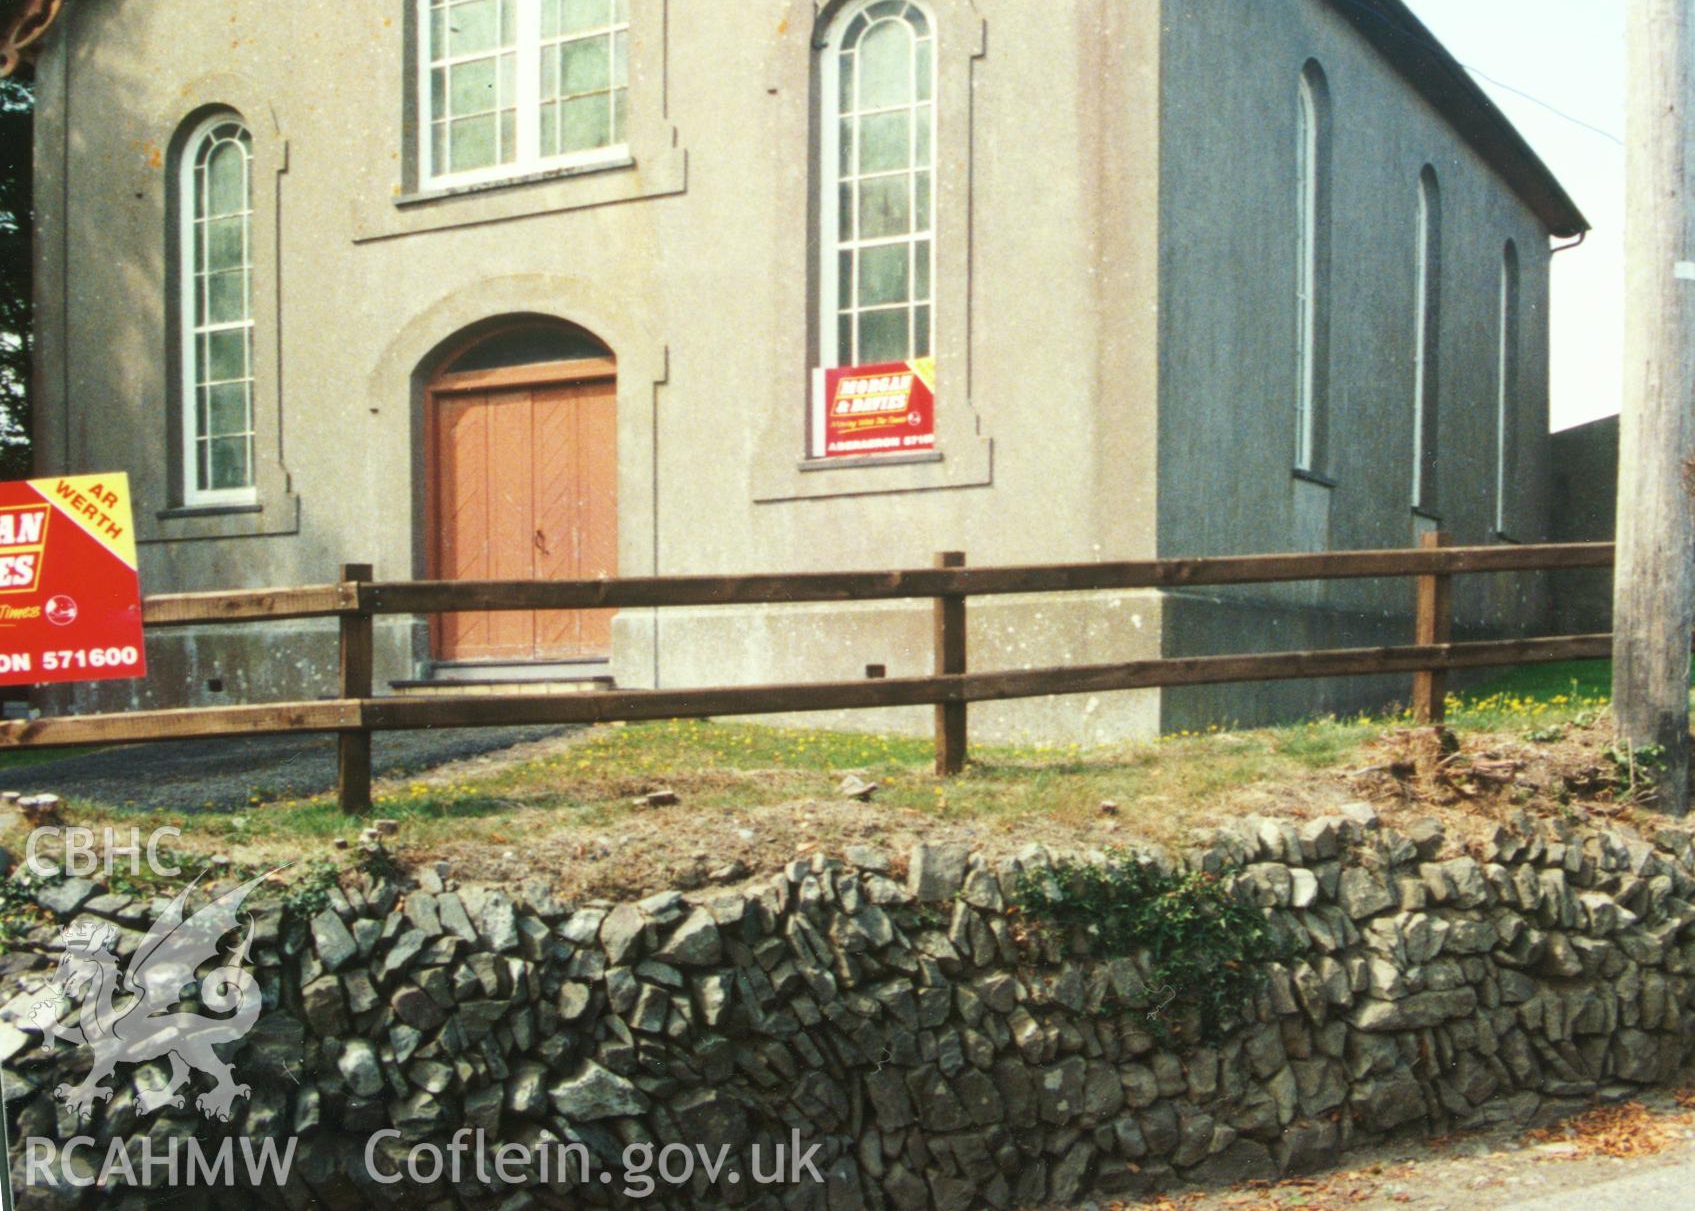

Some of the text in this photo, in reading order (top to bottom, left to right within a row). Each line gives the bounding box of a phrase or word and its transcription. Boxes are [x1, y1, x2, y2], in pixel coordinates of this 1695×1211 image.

[840, 375, 913, 395] MORGAN
[835, 394, 906, 414] & DAVIES
[89, 482, 119, 509] AR
[55, 479, 124, 540] WERTH
[42, 645, 138, 670] 571600
